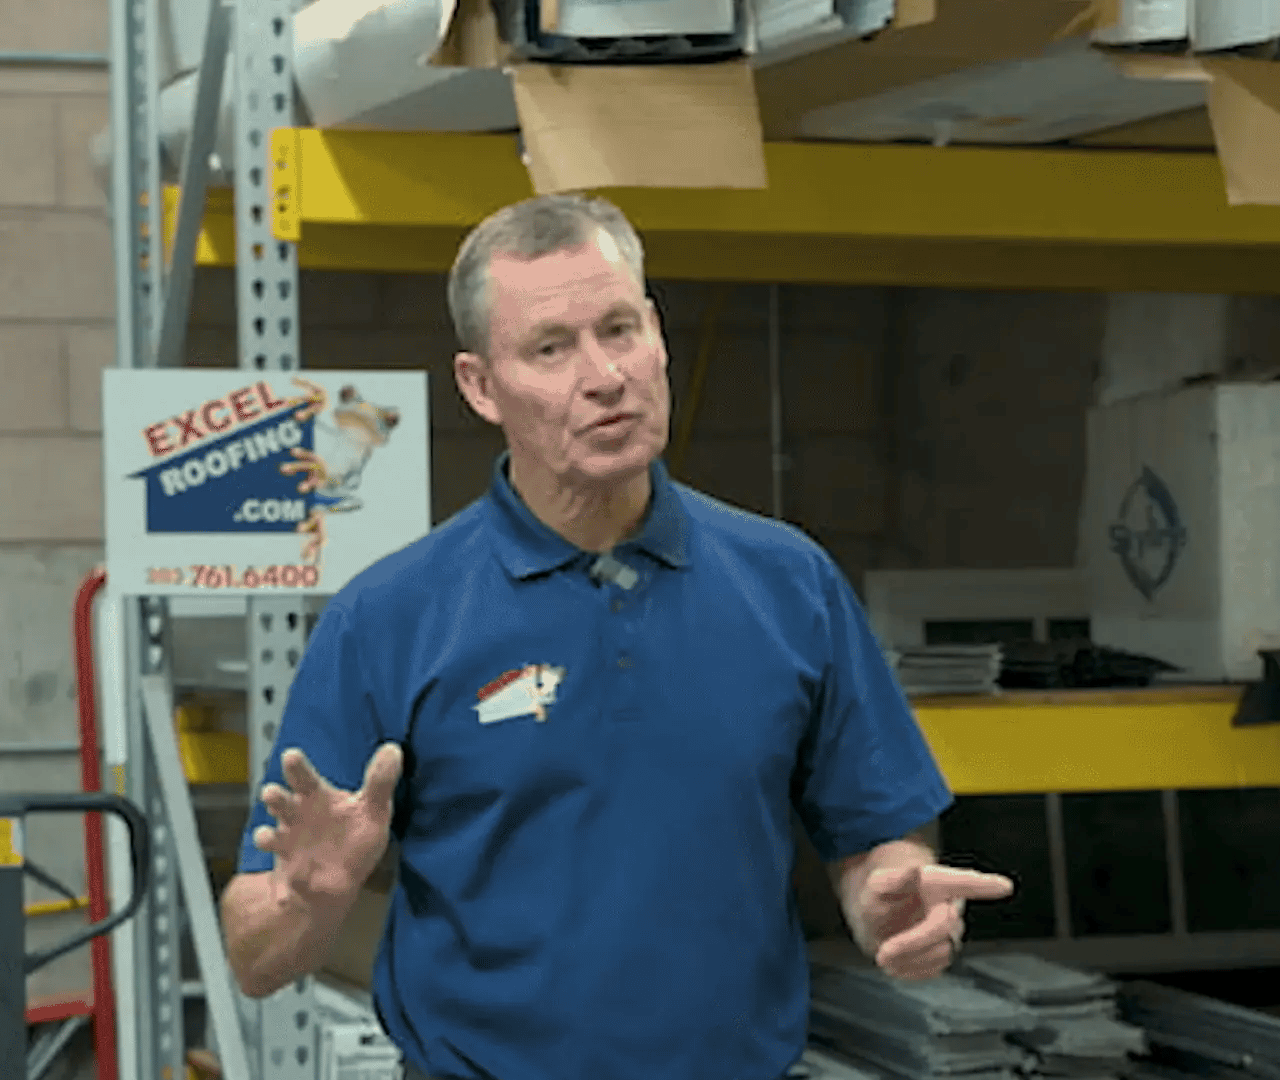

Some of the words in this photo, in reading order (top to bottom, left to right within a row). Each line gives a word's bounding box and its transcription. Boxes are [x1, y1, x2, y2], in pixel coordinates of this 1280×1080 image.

[143, 381, 286, 457] EXCEL
[158, 418, 304, 496] ROOFING
[233, 498, 306, 523] .COM
